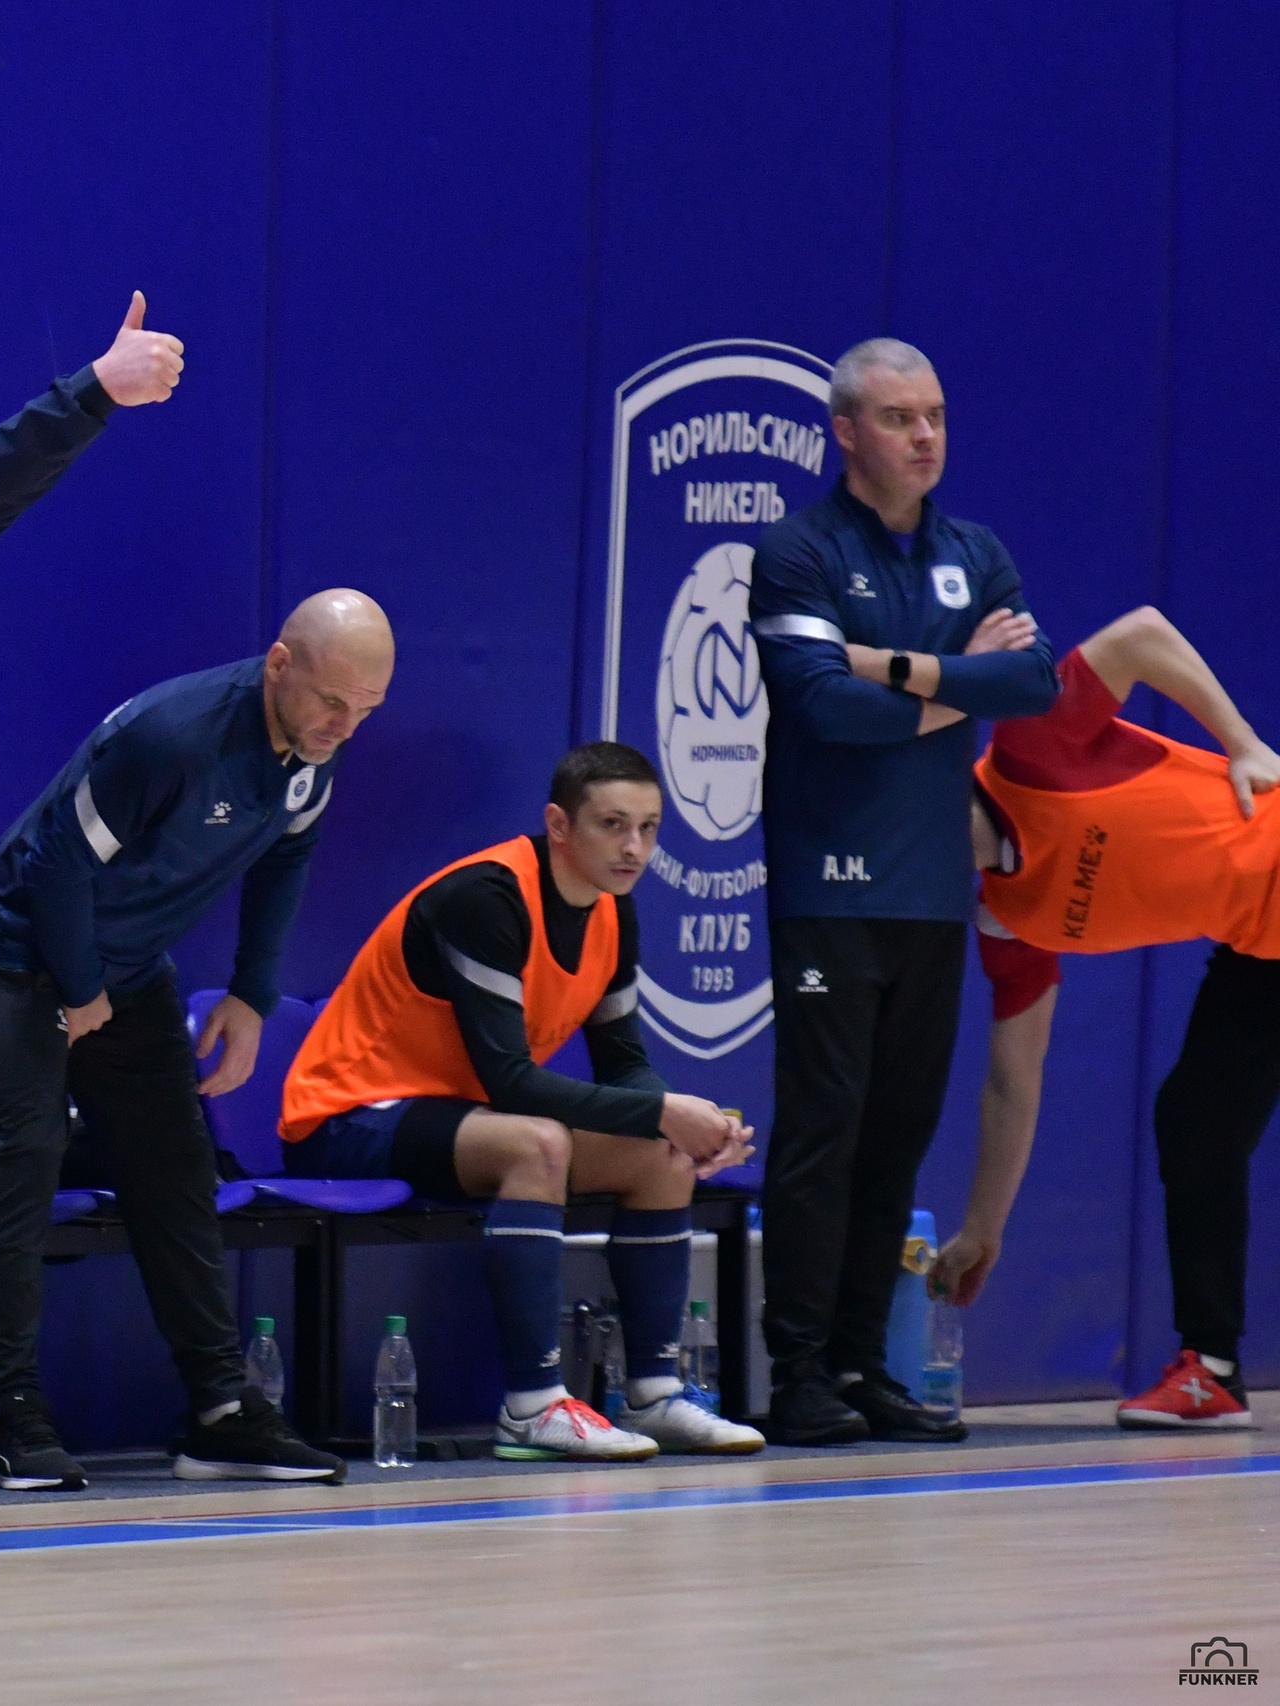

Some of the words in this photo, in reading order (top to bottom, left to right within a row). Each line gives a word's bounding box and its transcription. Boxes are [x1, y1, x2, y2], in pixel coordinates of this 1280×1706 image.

[650, 411, 826, 476] НОРИЛЬСКИЙ
[685, 481, 786, 523] НИКЕЛЬ
[691, 744, 760, 762] НОРНИКЕЛЬ
[1062, 847, 1102, 939] KELME
[678, 912, 751, 952] КЛУБ
[692, 966, 735, 992] 1993
